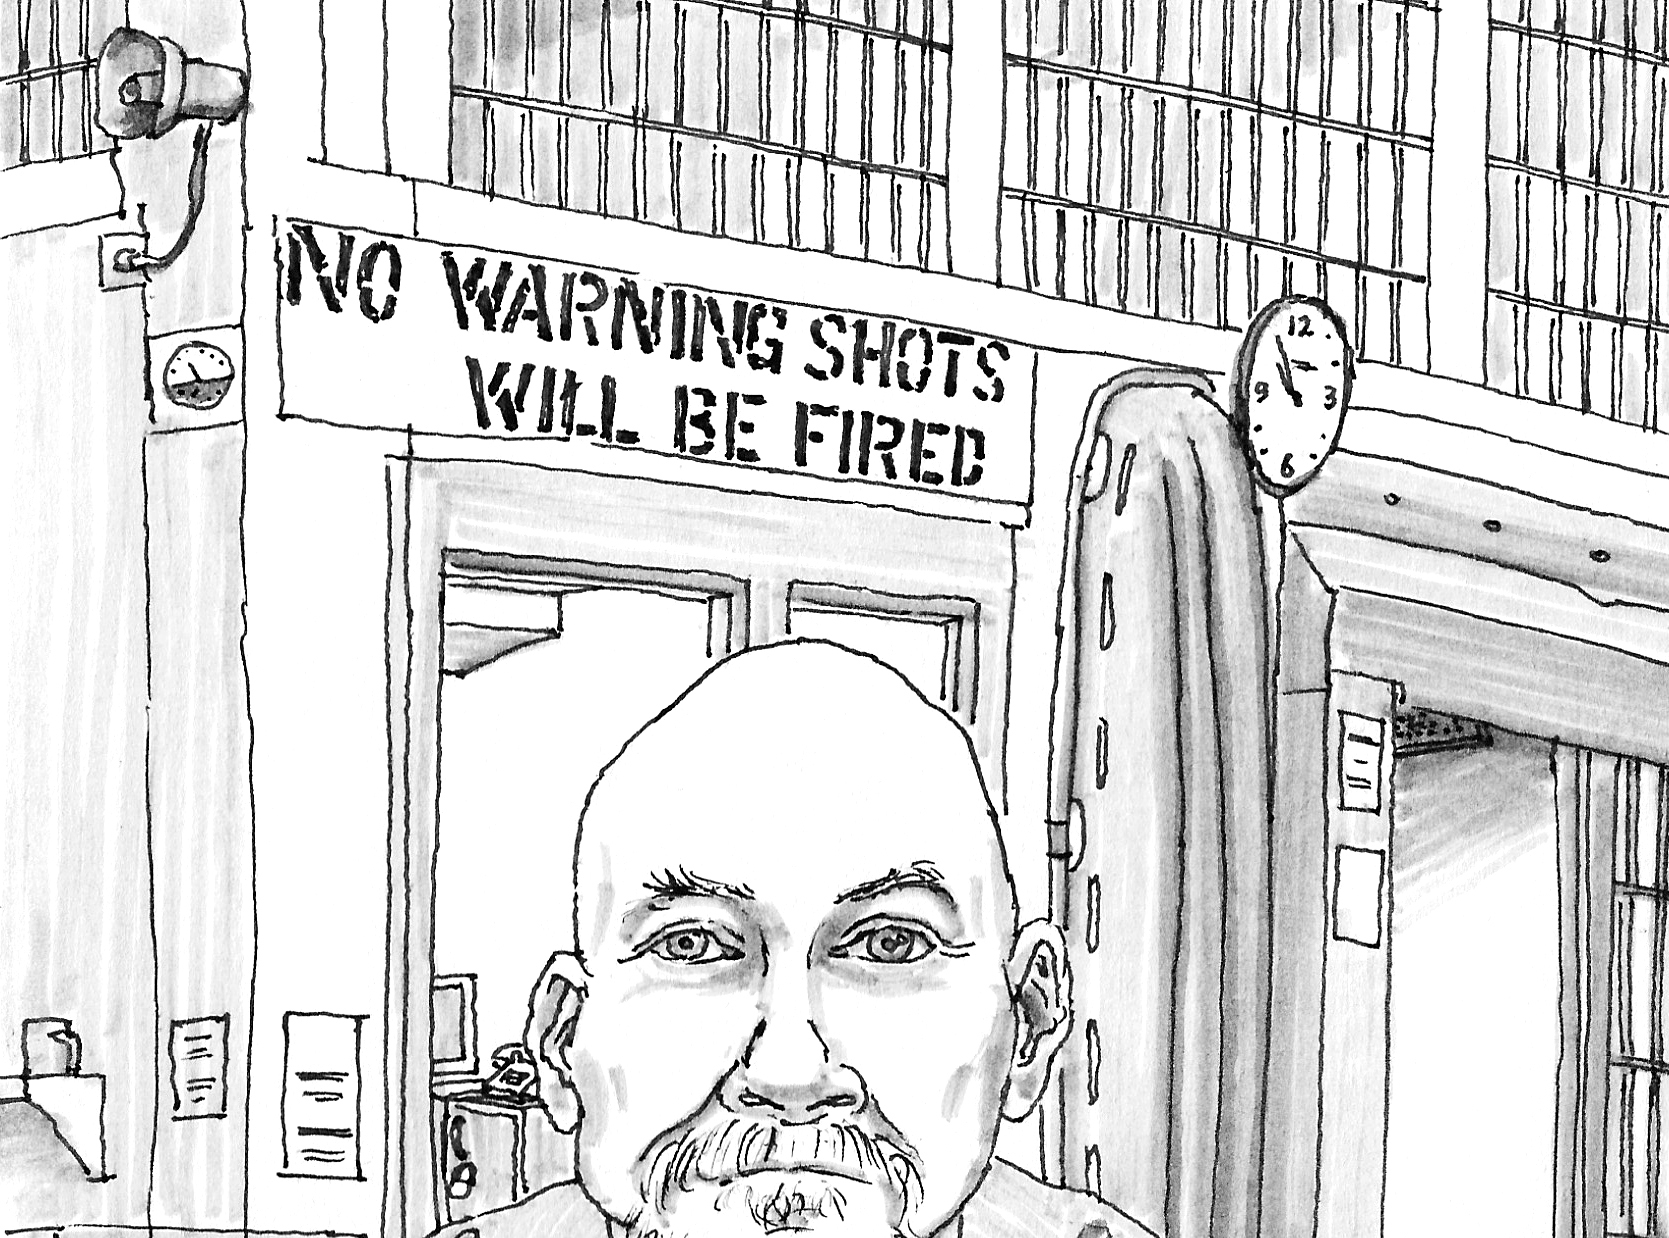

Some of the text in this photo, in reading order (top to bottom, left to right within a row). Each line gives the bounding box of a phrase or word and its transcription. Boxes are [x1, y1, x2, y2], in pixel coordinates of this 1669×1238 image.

[284, 222, 1010, 402] NO WARNING SHOTS
[1288, 315, 1315, 337] 12
[1254, 381, 1270, 404] 9
[1324, 385, 1338, 411] 3
[465, 356, 986, 487] WILL BE FIRED
[1280, 453, 1295, 478] 6
